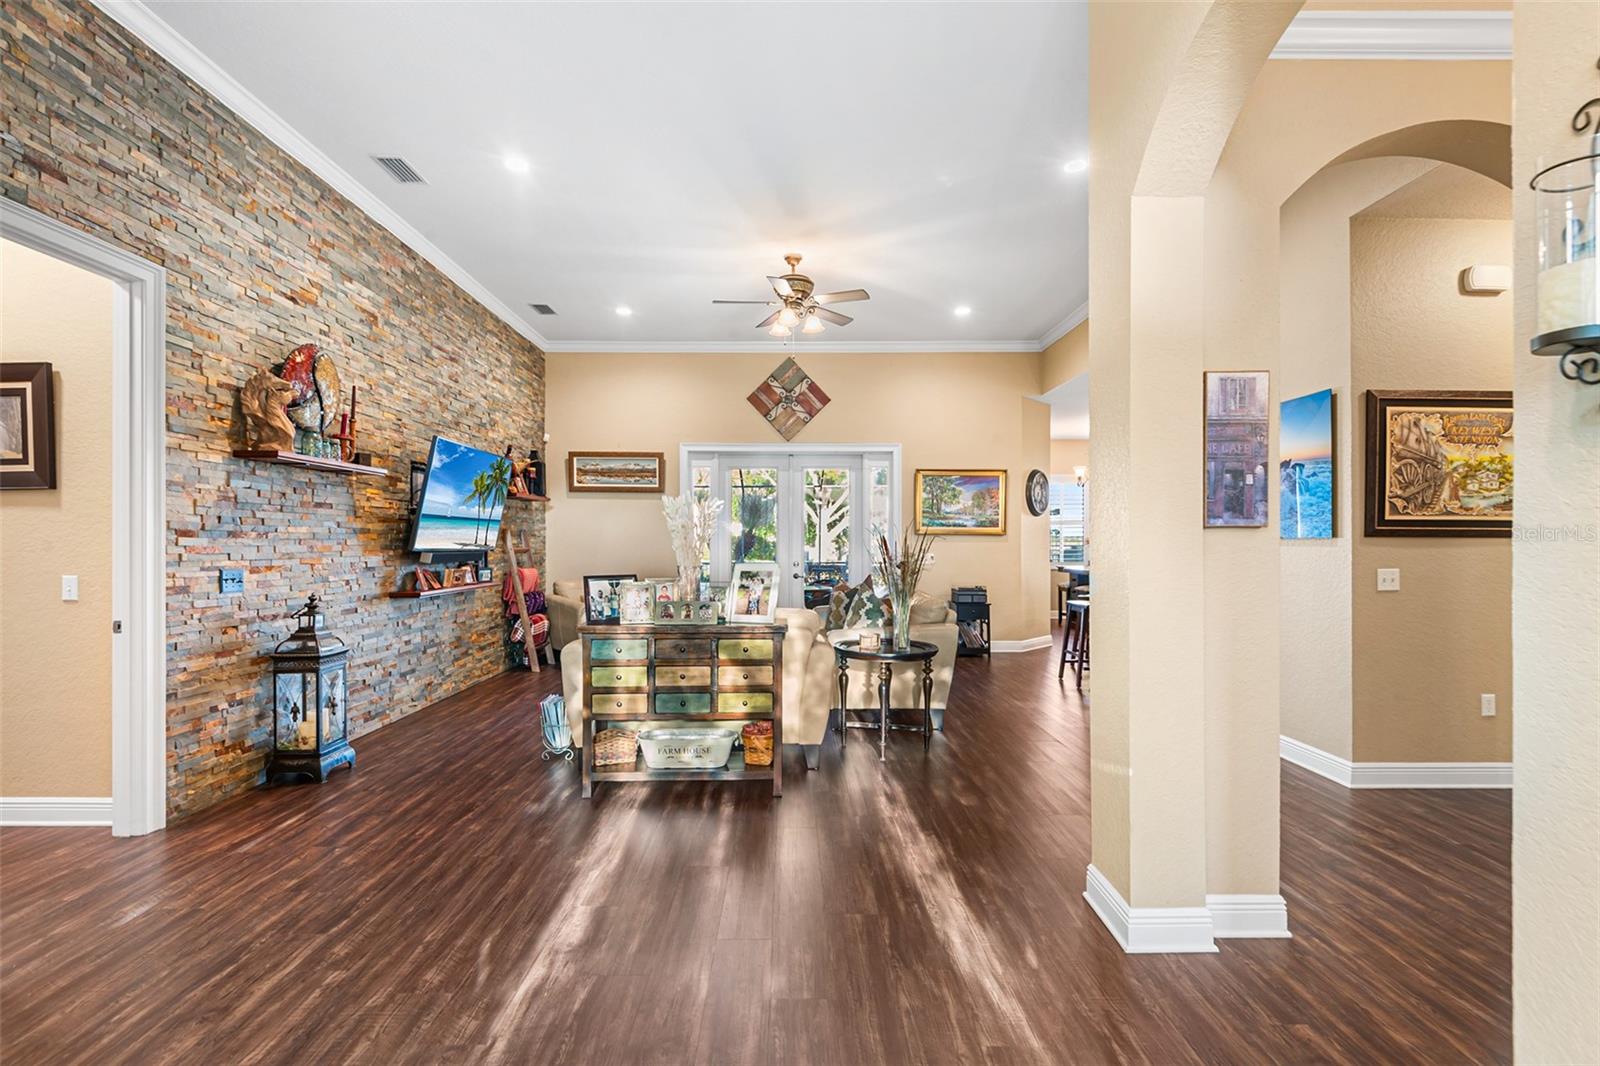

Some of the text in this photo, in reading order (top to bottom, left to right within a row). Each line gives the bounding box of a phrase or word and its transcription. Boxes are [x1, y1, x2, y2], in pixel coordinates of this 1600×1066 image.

[1452, 426, 1498, 435] KEY WEST
[658, 746, 712, 755] FARM HOUSE
